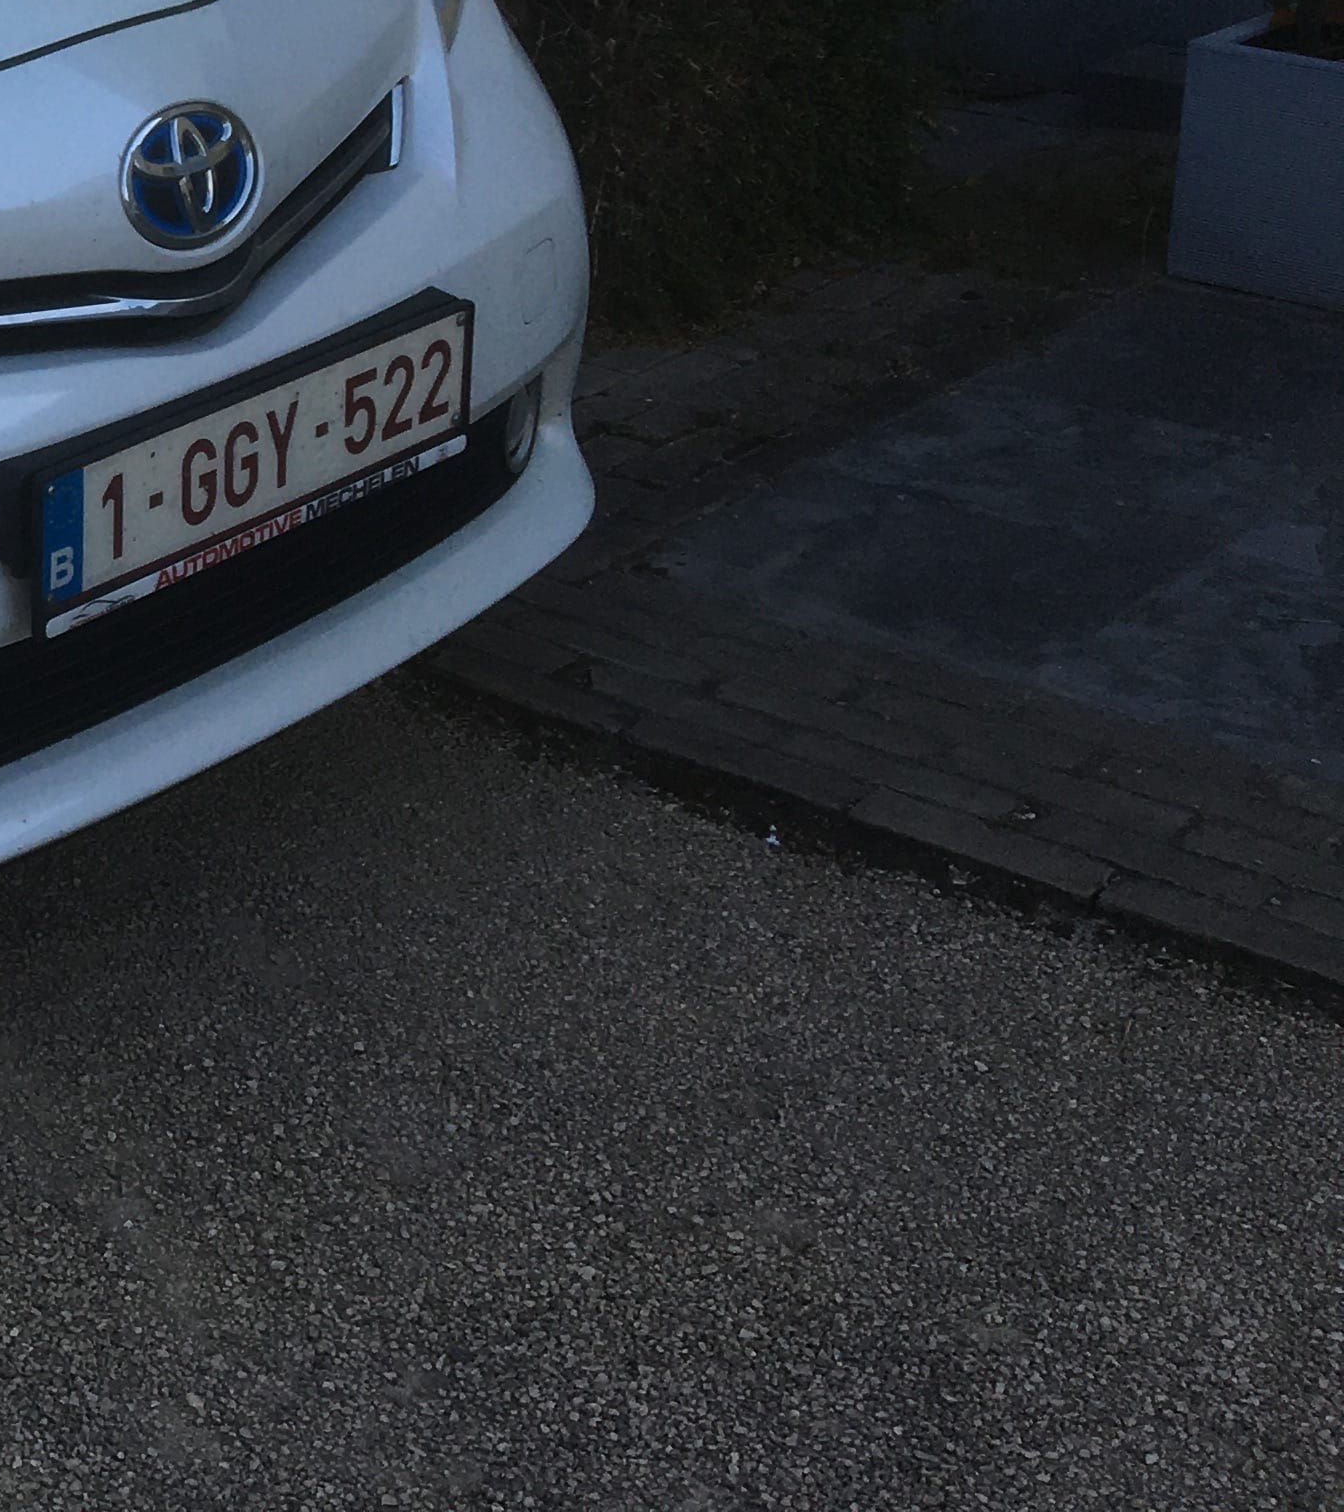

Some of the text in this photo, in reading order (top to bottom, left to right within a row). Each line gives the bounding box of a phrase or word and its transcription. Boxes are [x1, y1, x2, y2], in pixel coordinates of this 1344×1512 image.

[102, 339, 453, 561] 1-GGY-522
[50, 546, 75, 590] B
[155, 456, 420, 590] AUTOMOTIVE MECHELEN
